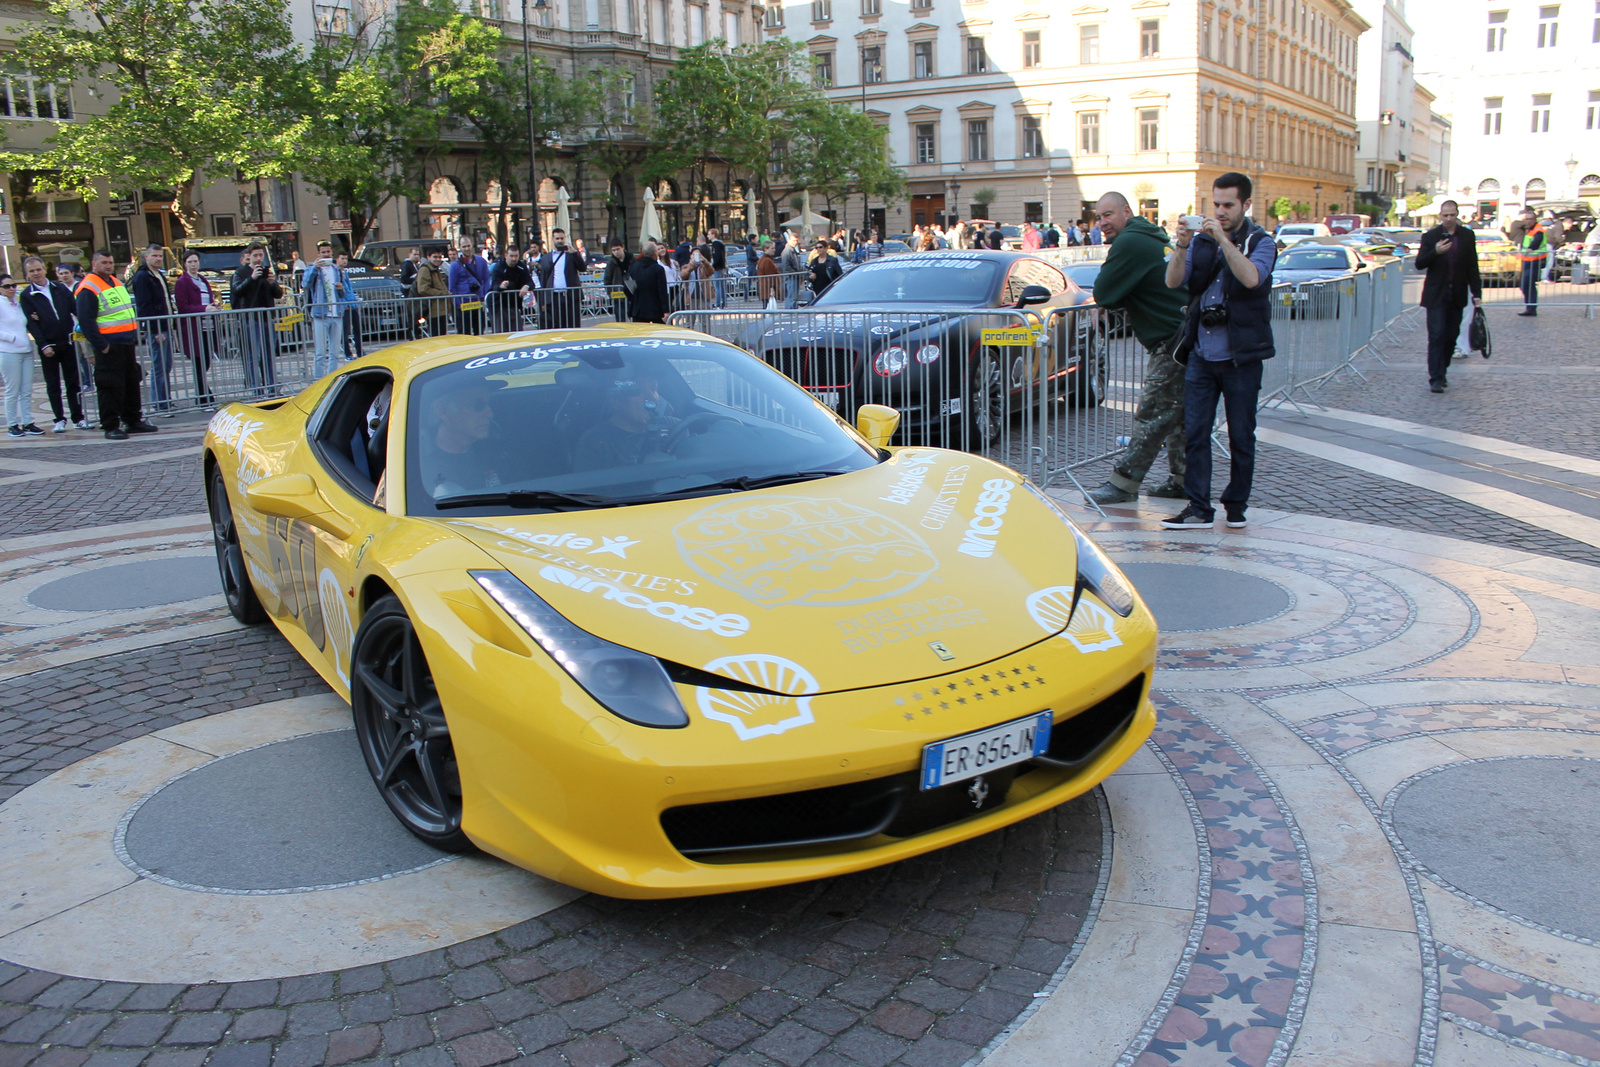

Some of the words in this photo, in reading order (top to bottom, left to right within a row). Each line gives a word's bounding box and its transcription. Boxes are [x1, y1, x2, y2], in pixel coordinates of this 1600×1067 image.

[862, 260, 935, 272] GUMBALL
[934, 259, 982, 269] 3000
[984, 331, 1028, 342] profirent
[464, 341, 629, 370] California
[640, 339, 705, 348] Gold
[919, 464, 971, 530] CHRISTIE'S
[496, 540, 698, 596] CHRISTIE'S
[834, 600, 929, 635] DUBLIN
[926, 596, 964, 614] TO
[841, 608, 988, 654] BUCHAREST
[944, 746, 970, 776] ER
